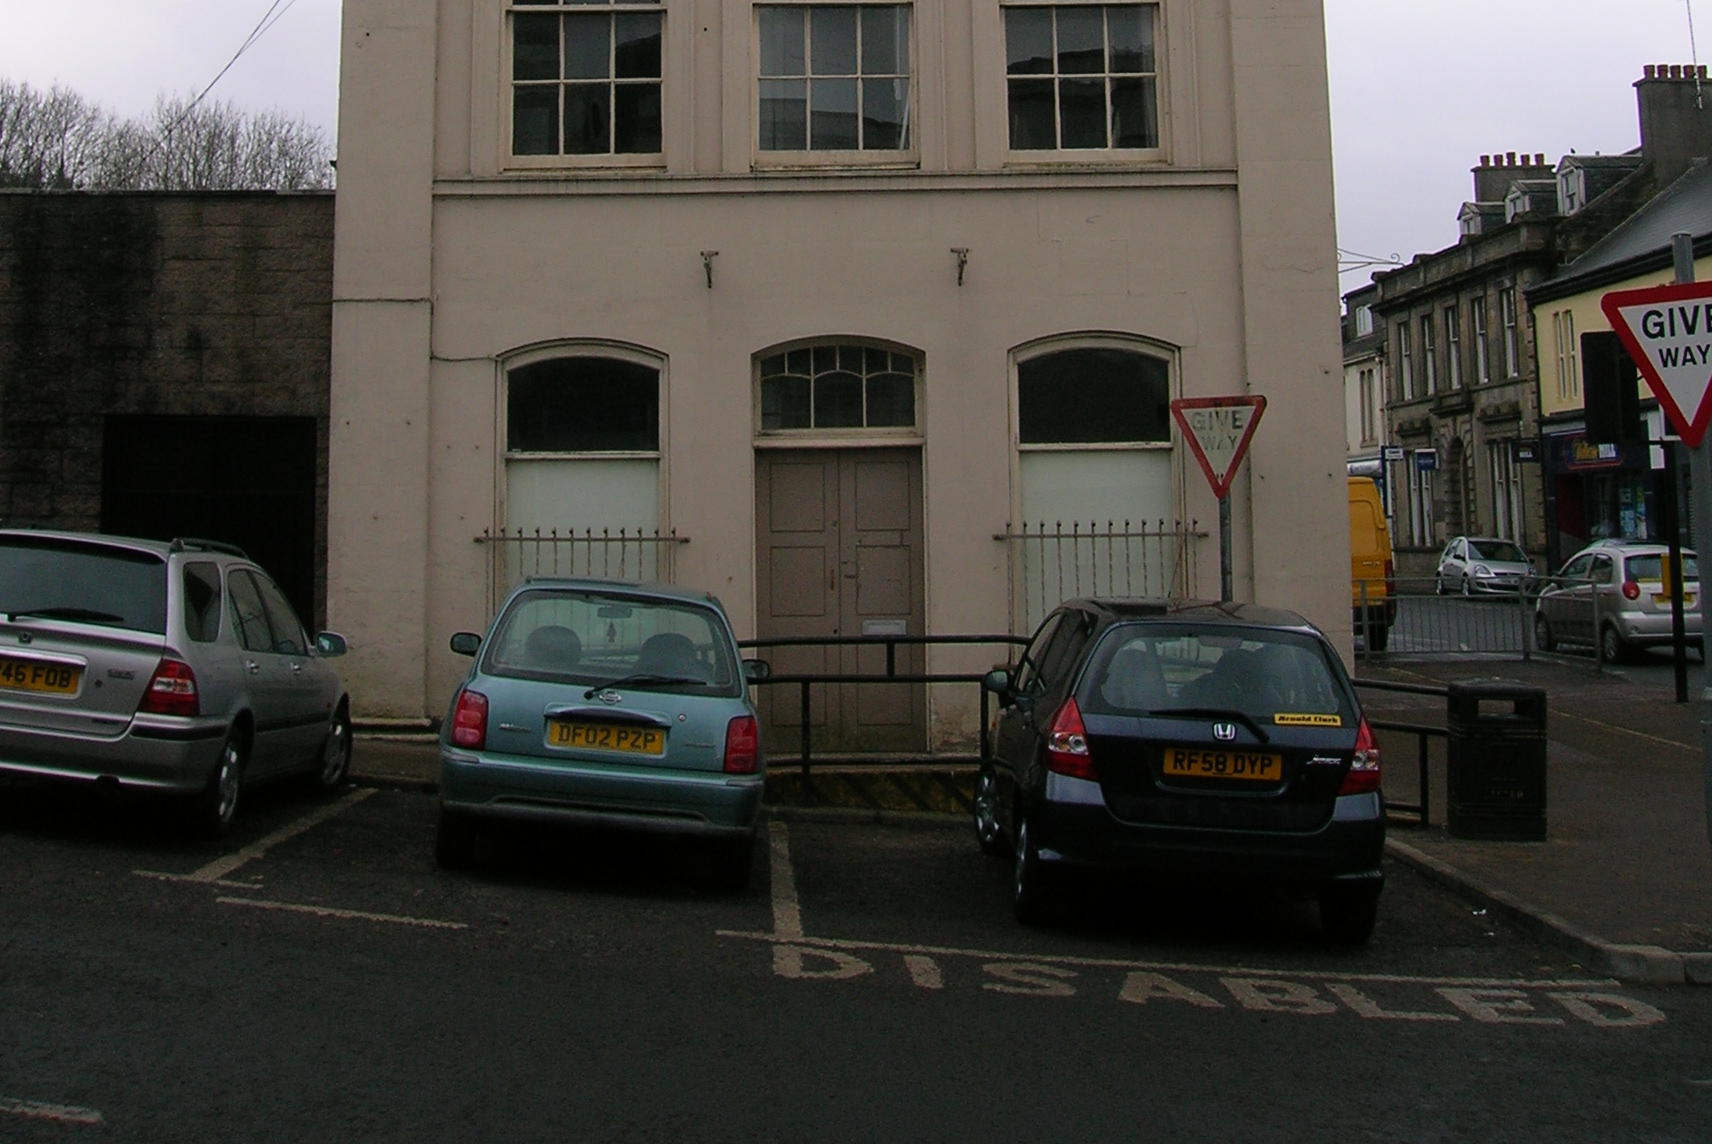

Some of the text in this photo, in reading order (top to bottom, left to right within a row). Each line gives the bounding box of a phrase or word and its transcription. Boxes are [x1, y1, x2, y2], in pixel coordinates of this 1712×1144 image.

[1658, 344, 1711, 368] WAY
[558, 723, 656, 750] DF02 PZP
[1173, 750, 1273, 775] RF58 DYP
[772, 943, 1667, 1028] DISABLED
